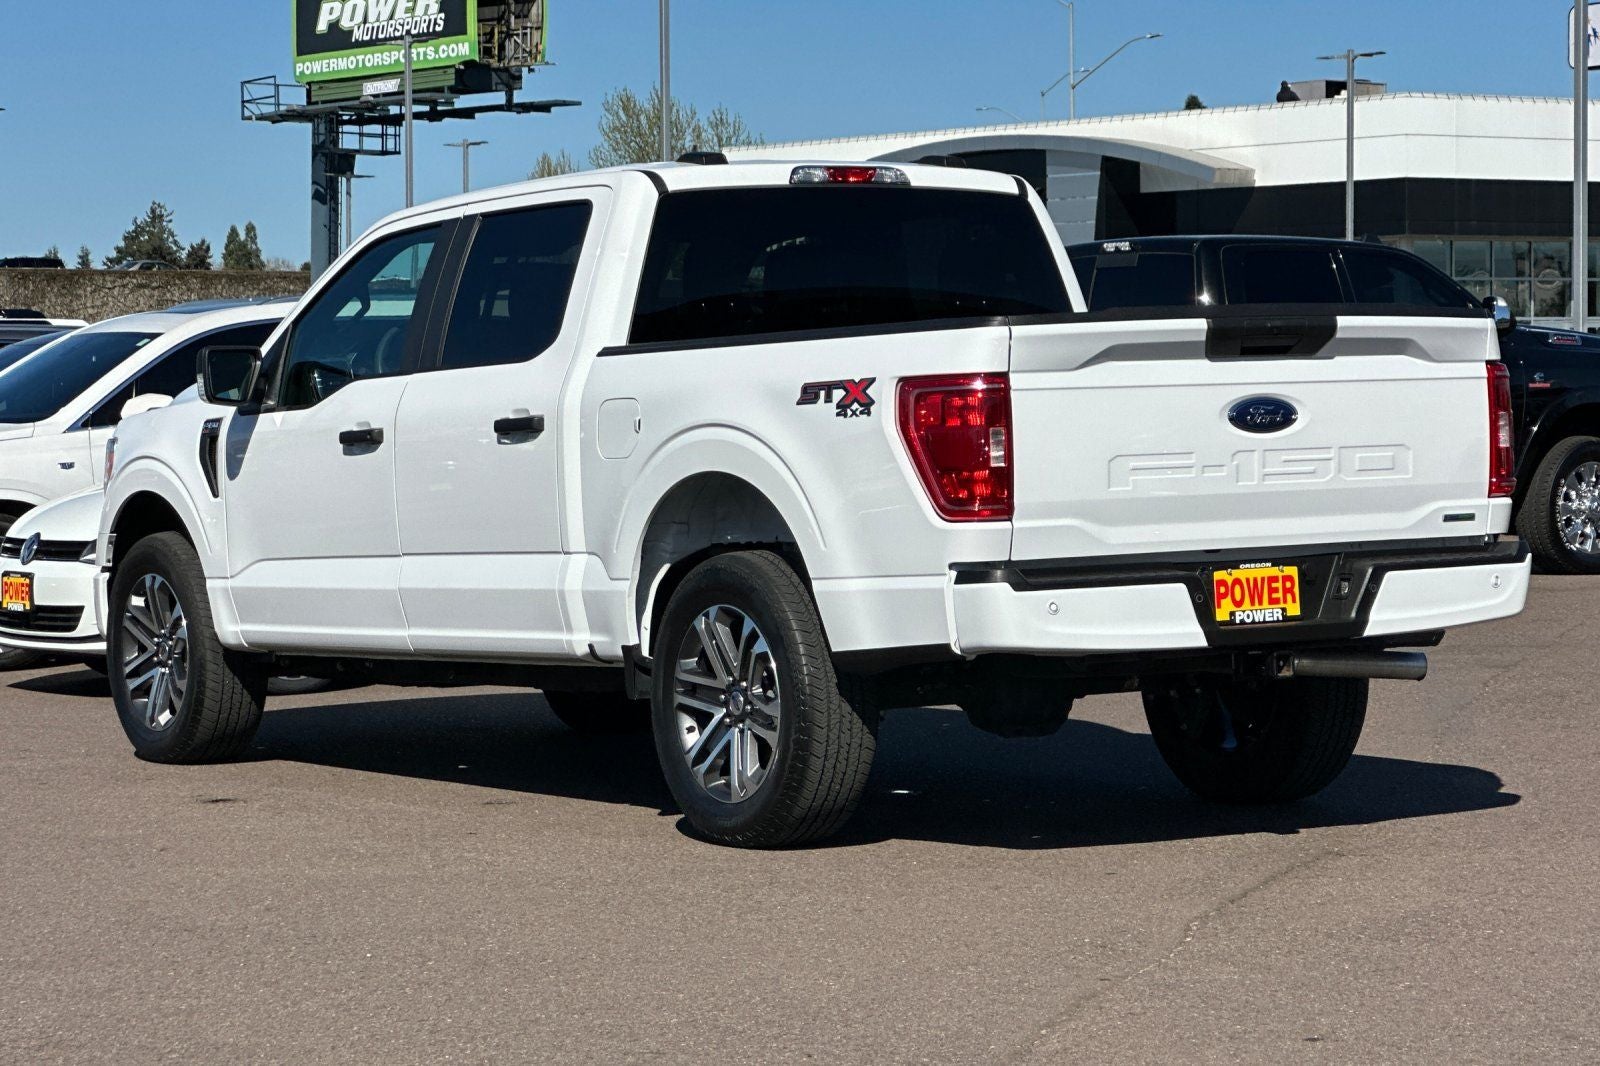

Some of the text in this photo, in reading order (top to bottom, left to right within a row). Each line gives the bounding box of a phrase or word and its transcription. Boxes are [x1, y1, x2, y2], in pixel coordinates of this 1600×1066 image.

[316, 0, 440, 33] POWER
[352, 13, 445, 42] MOTORSPORTS
[796, 377, 877, 409] STX
[1108, 443, 1413, 491] F-150
[4, 581, 30, 601] POWER
[1215, 574, 1297, 609] POWER
[1235, 608, 1283, 624] POWER
